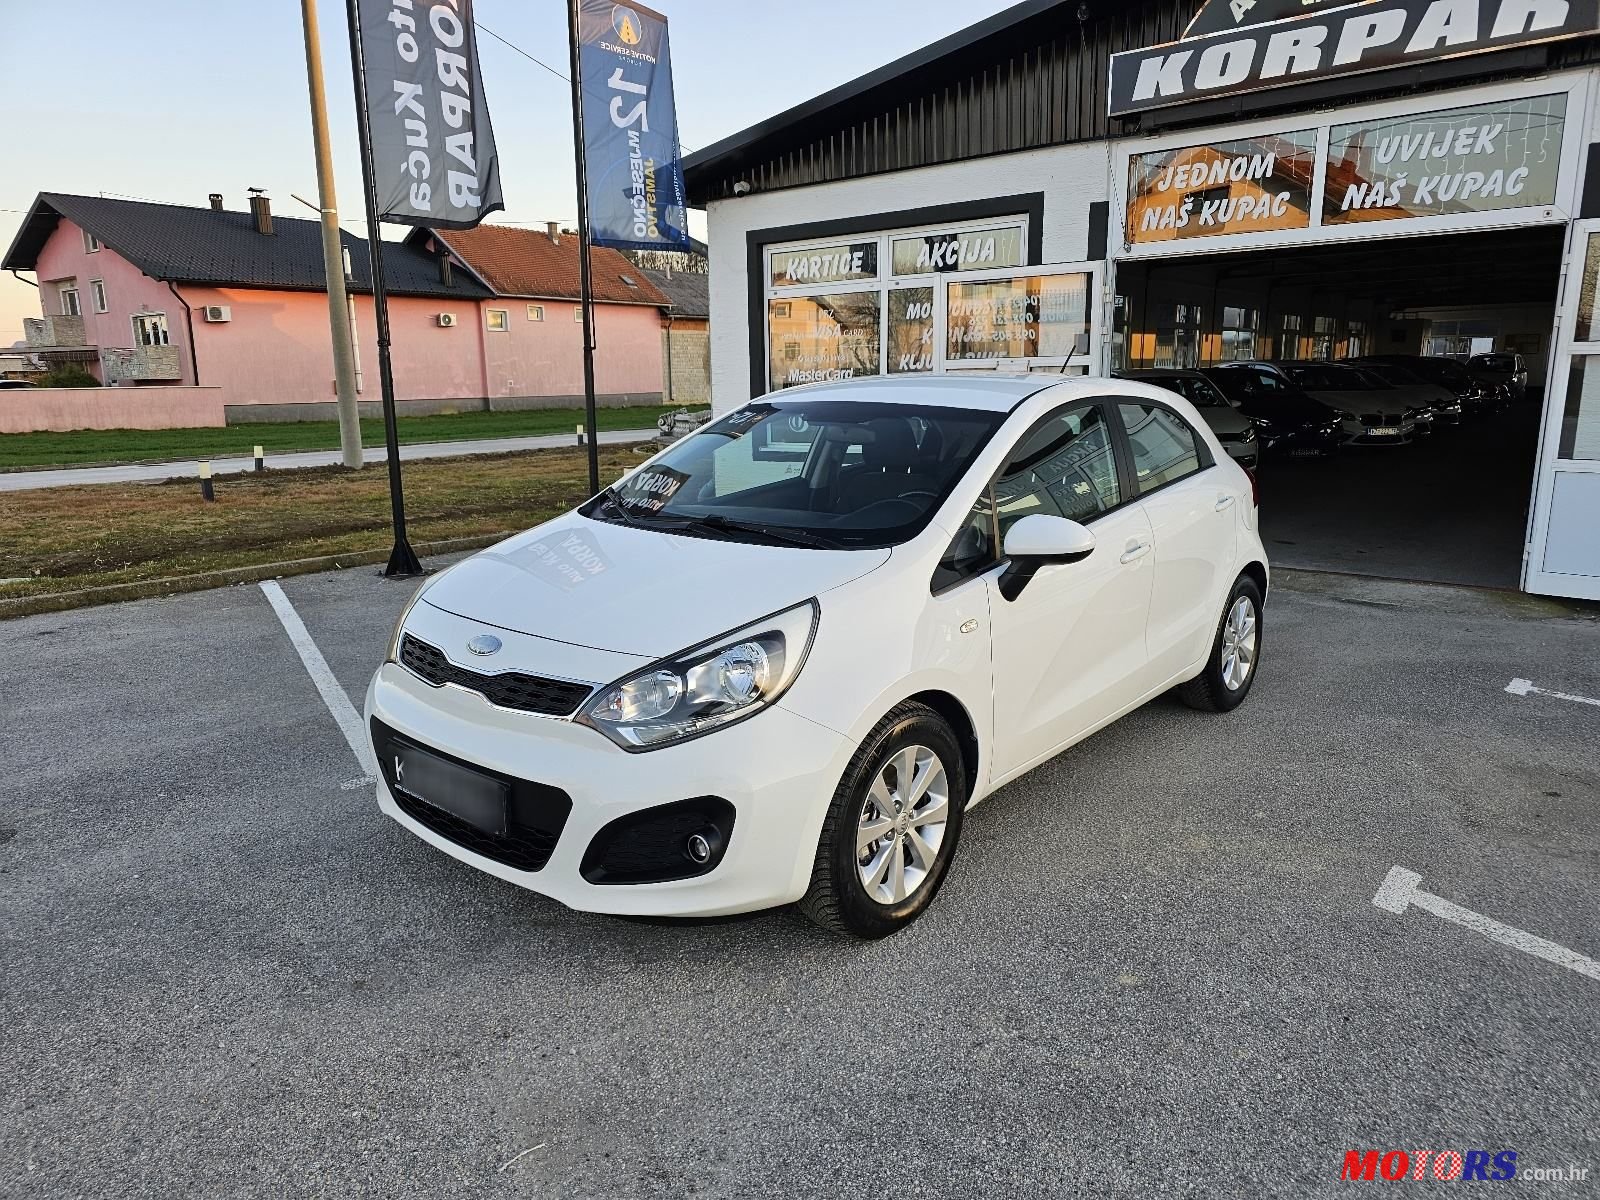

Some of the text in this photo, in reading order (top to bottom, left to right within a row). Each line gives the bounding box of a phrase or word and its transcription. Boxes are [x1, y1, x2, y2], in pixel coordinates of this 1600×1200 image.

[1377, 124, 1504, 165] UVIJEK
[1157, 152, 1275, 192] JEDNOM
[1340, 165, 1530, 212] NAŠ KUPAC
[1141, 191, 1291, 233] NAŠ KUPAC
[785, 250, 864, 281] KARTICE
[916, 236, 996, 272] AKCIJA
[813, 323, 842, 338] VISA
[788, 367, 853, 382] MasterCard
